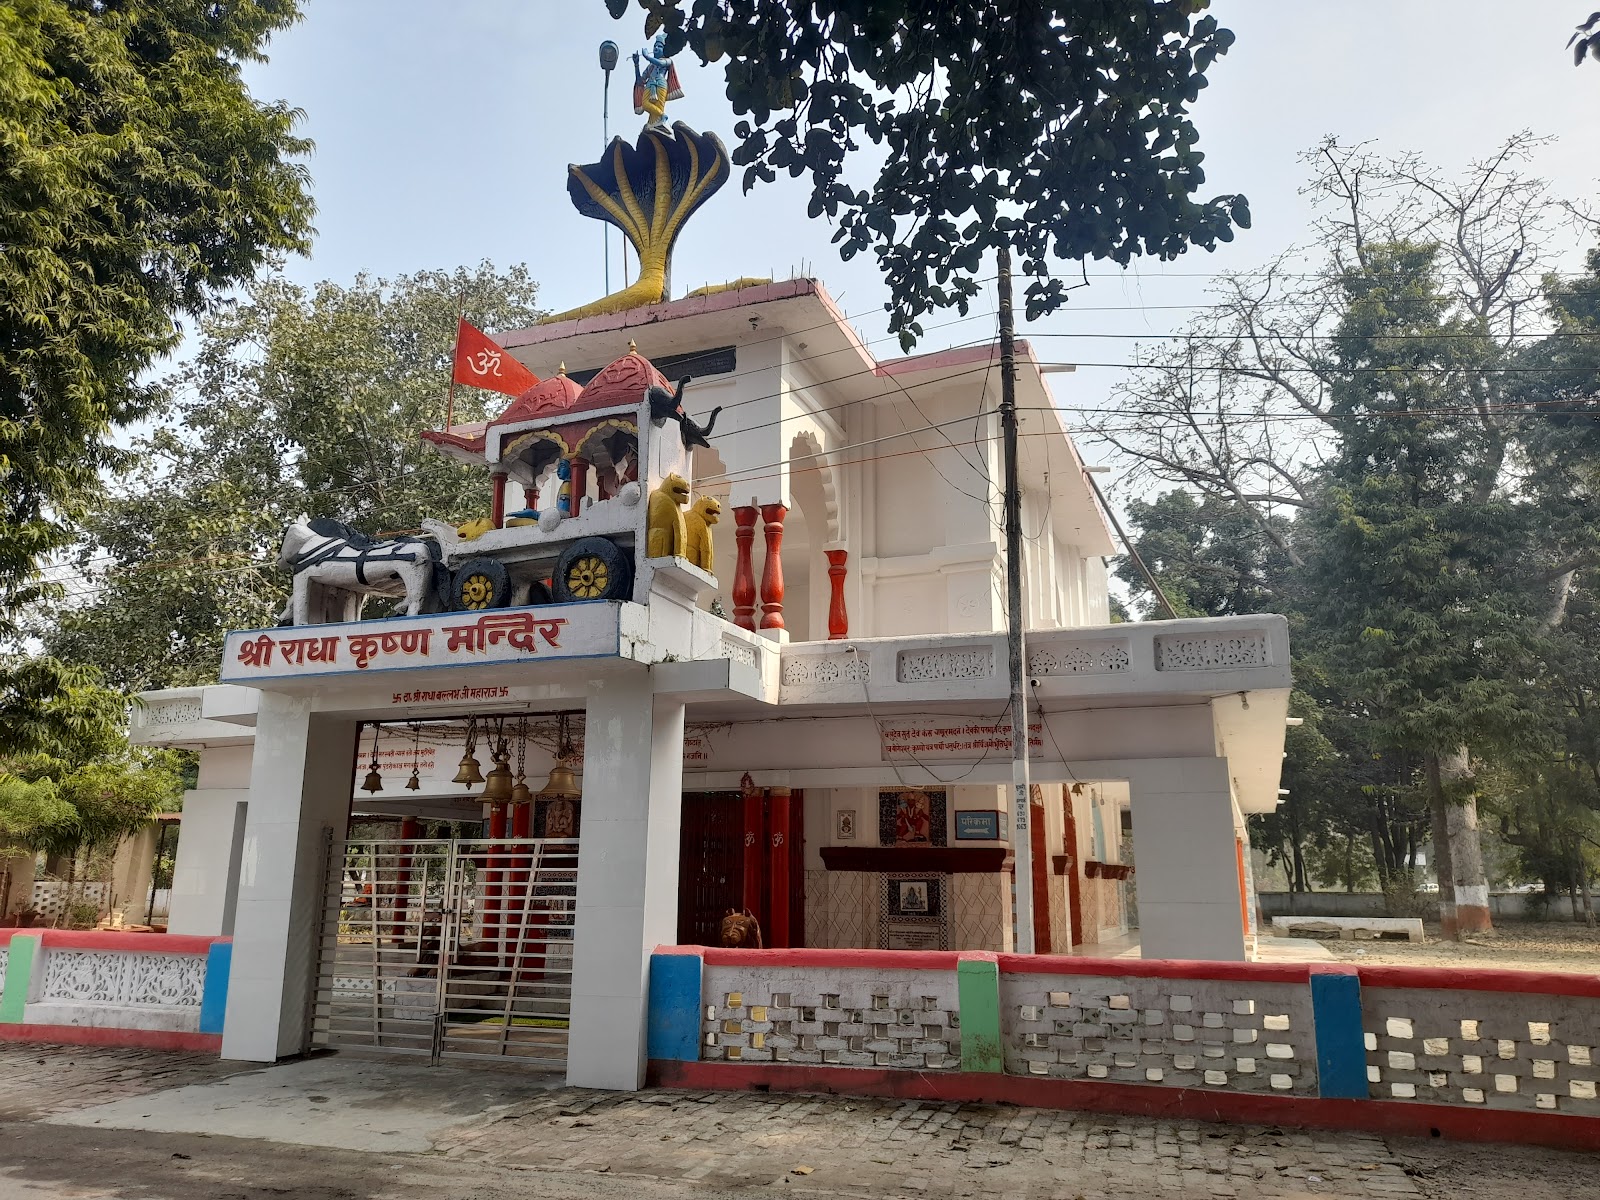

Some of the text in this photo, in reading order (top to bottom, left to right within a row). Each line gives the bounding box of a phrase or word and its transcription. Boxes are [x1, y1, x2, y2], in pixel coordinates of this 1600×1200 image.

[237, 633, 275, 668] श्री
[278, 636, 342, 666] राधा
[347, 629, 435, 669] कृष्ण
[469, 686, 498, 701] महाराज
